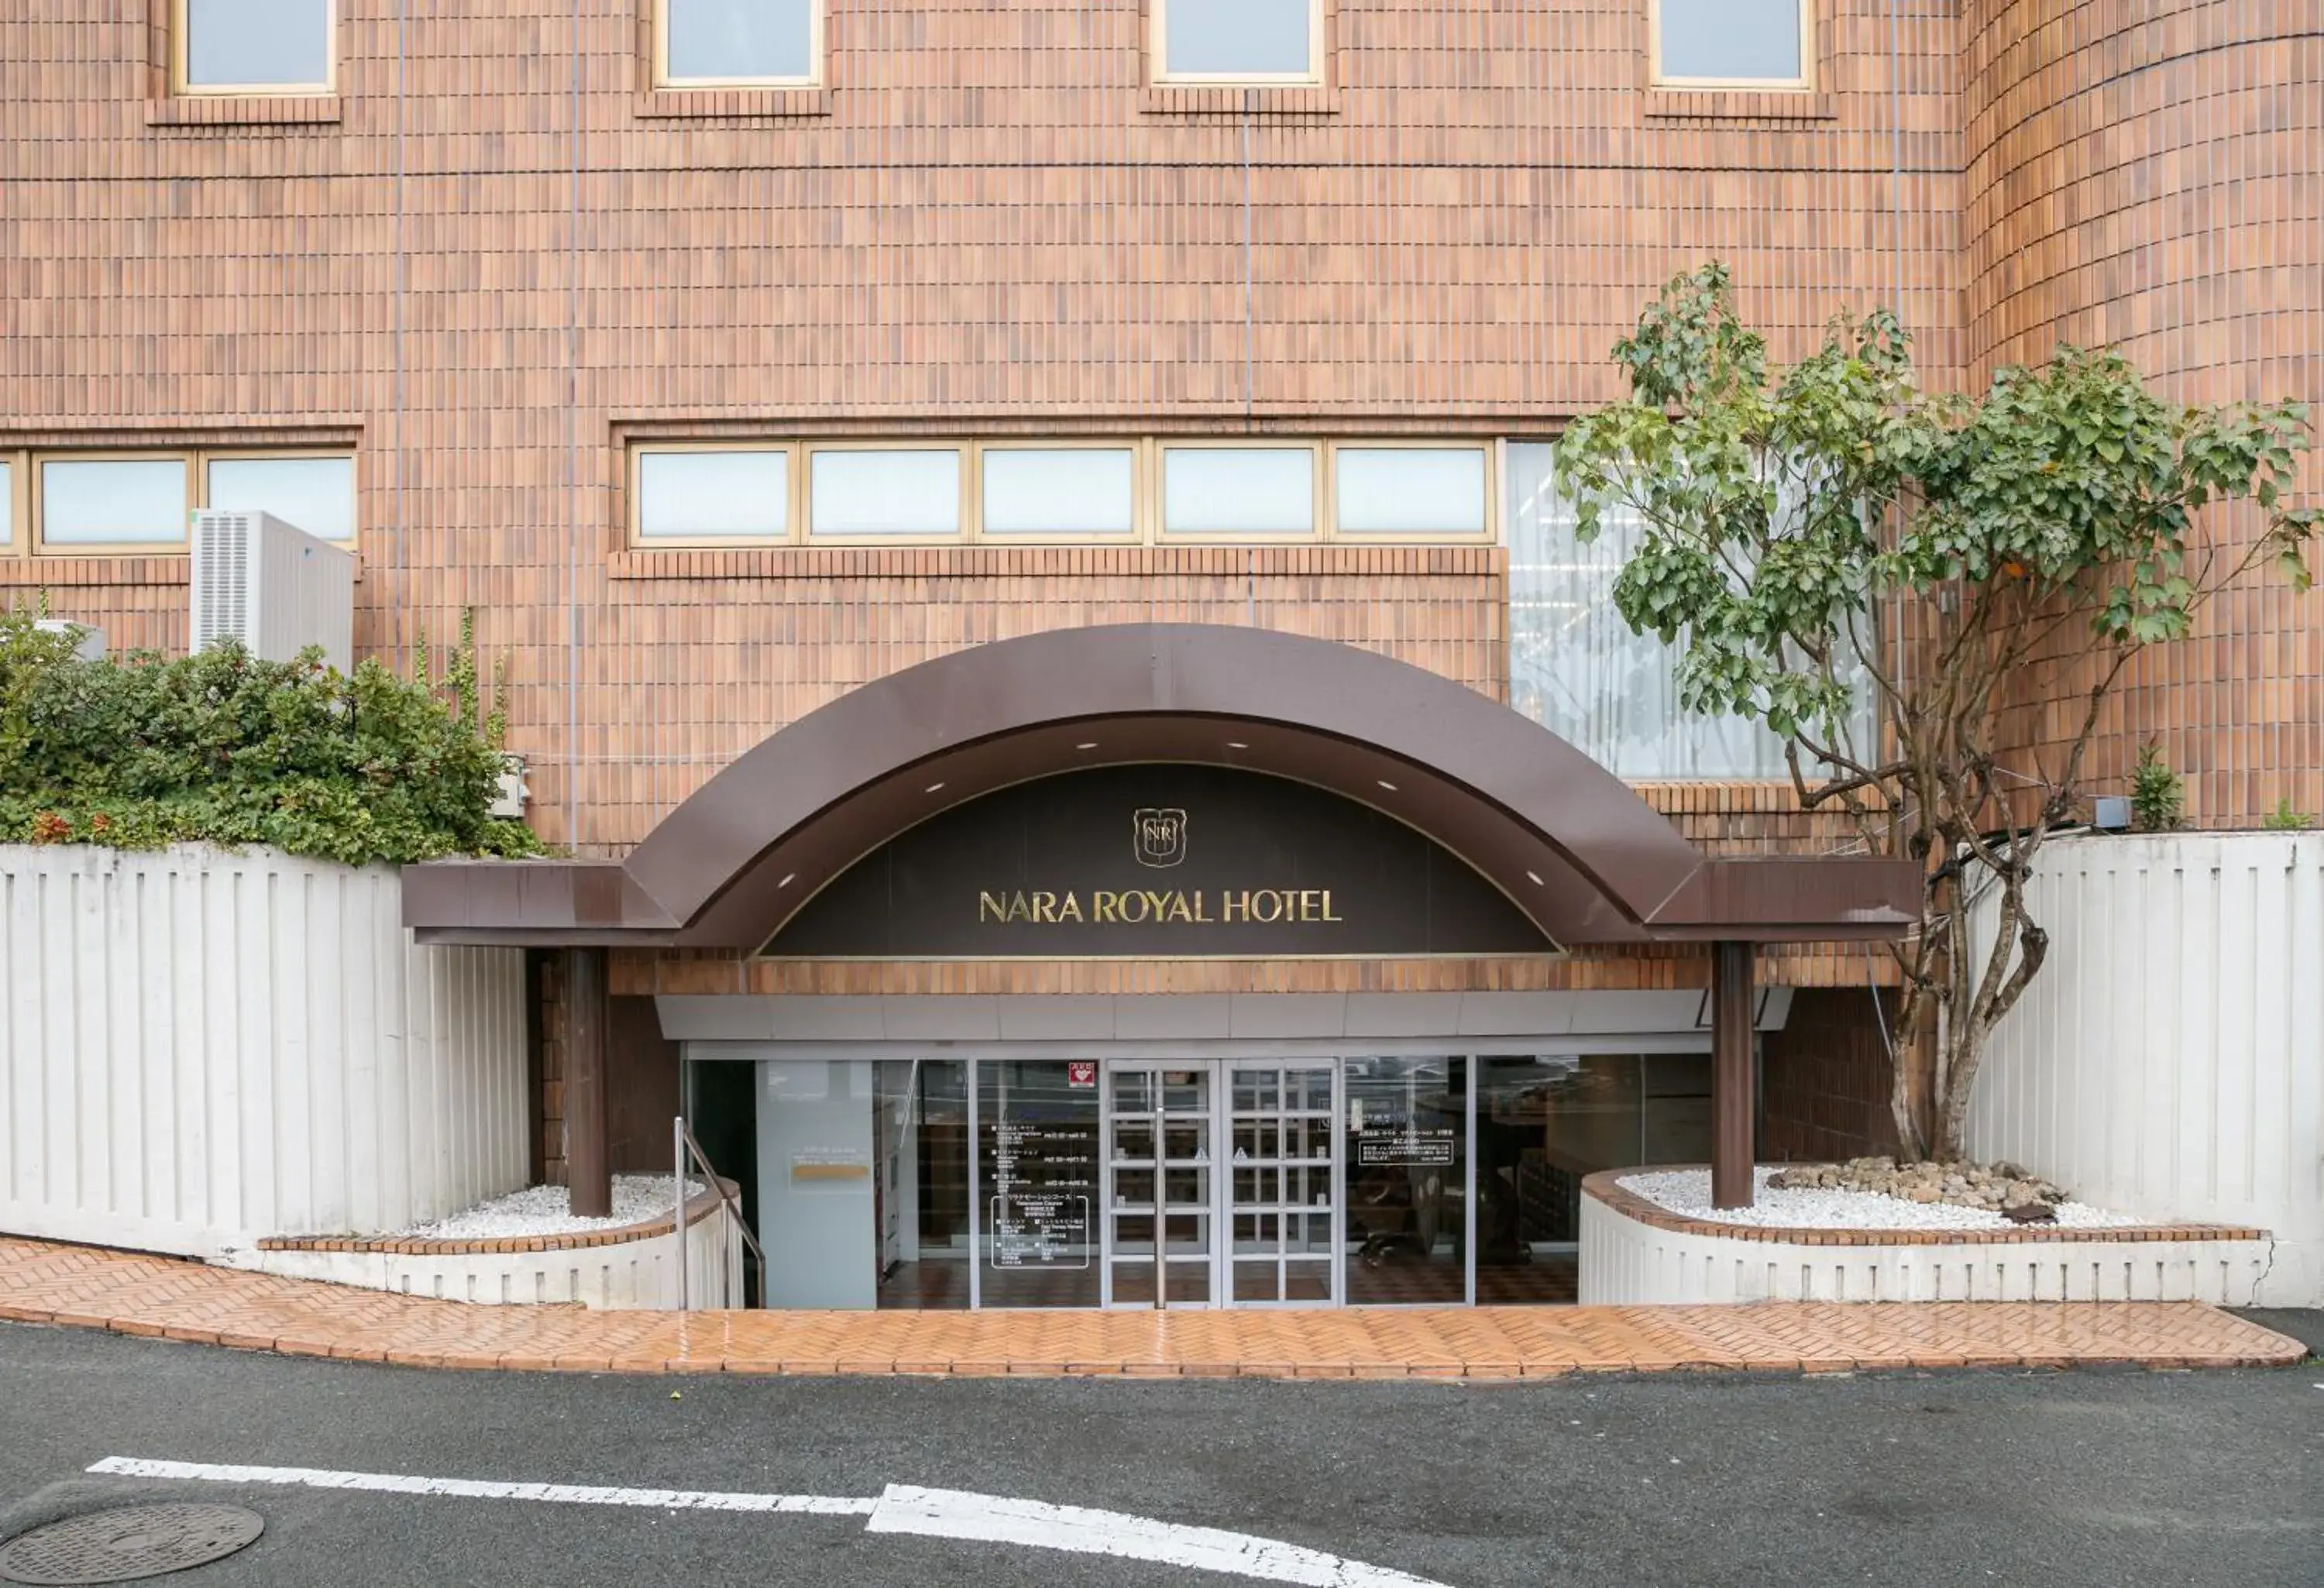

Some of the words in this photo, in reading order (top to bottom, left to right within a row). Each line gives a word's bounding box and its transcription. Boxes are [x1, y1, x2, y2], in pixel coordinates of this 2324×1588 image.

[979, 890, 1083, 923] NARA
[1093, 889, 1214, 923] ROYAL
[1223, 889, 1343, 922] HOTEL
